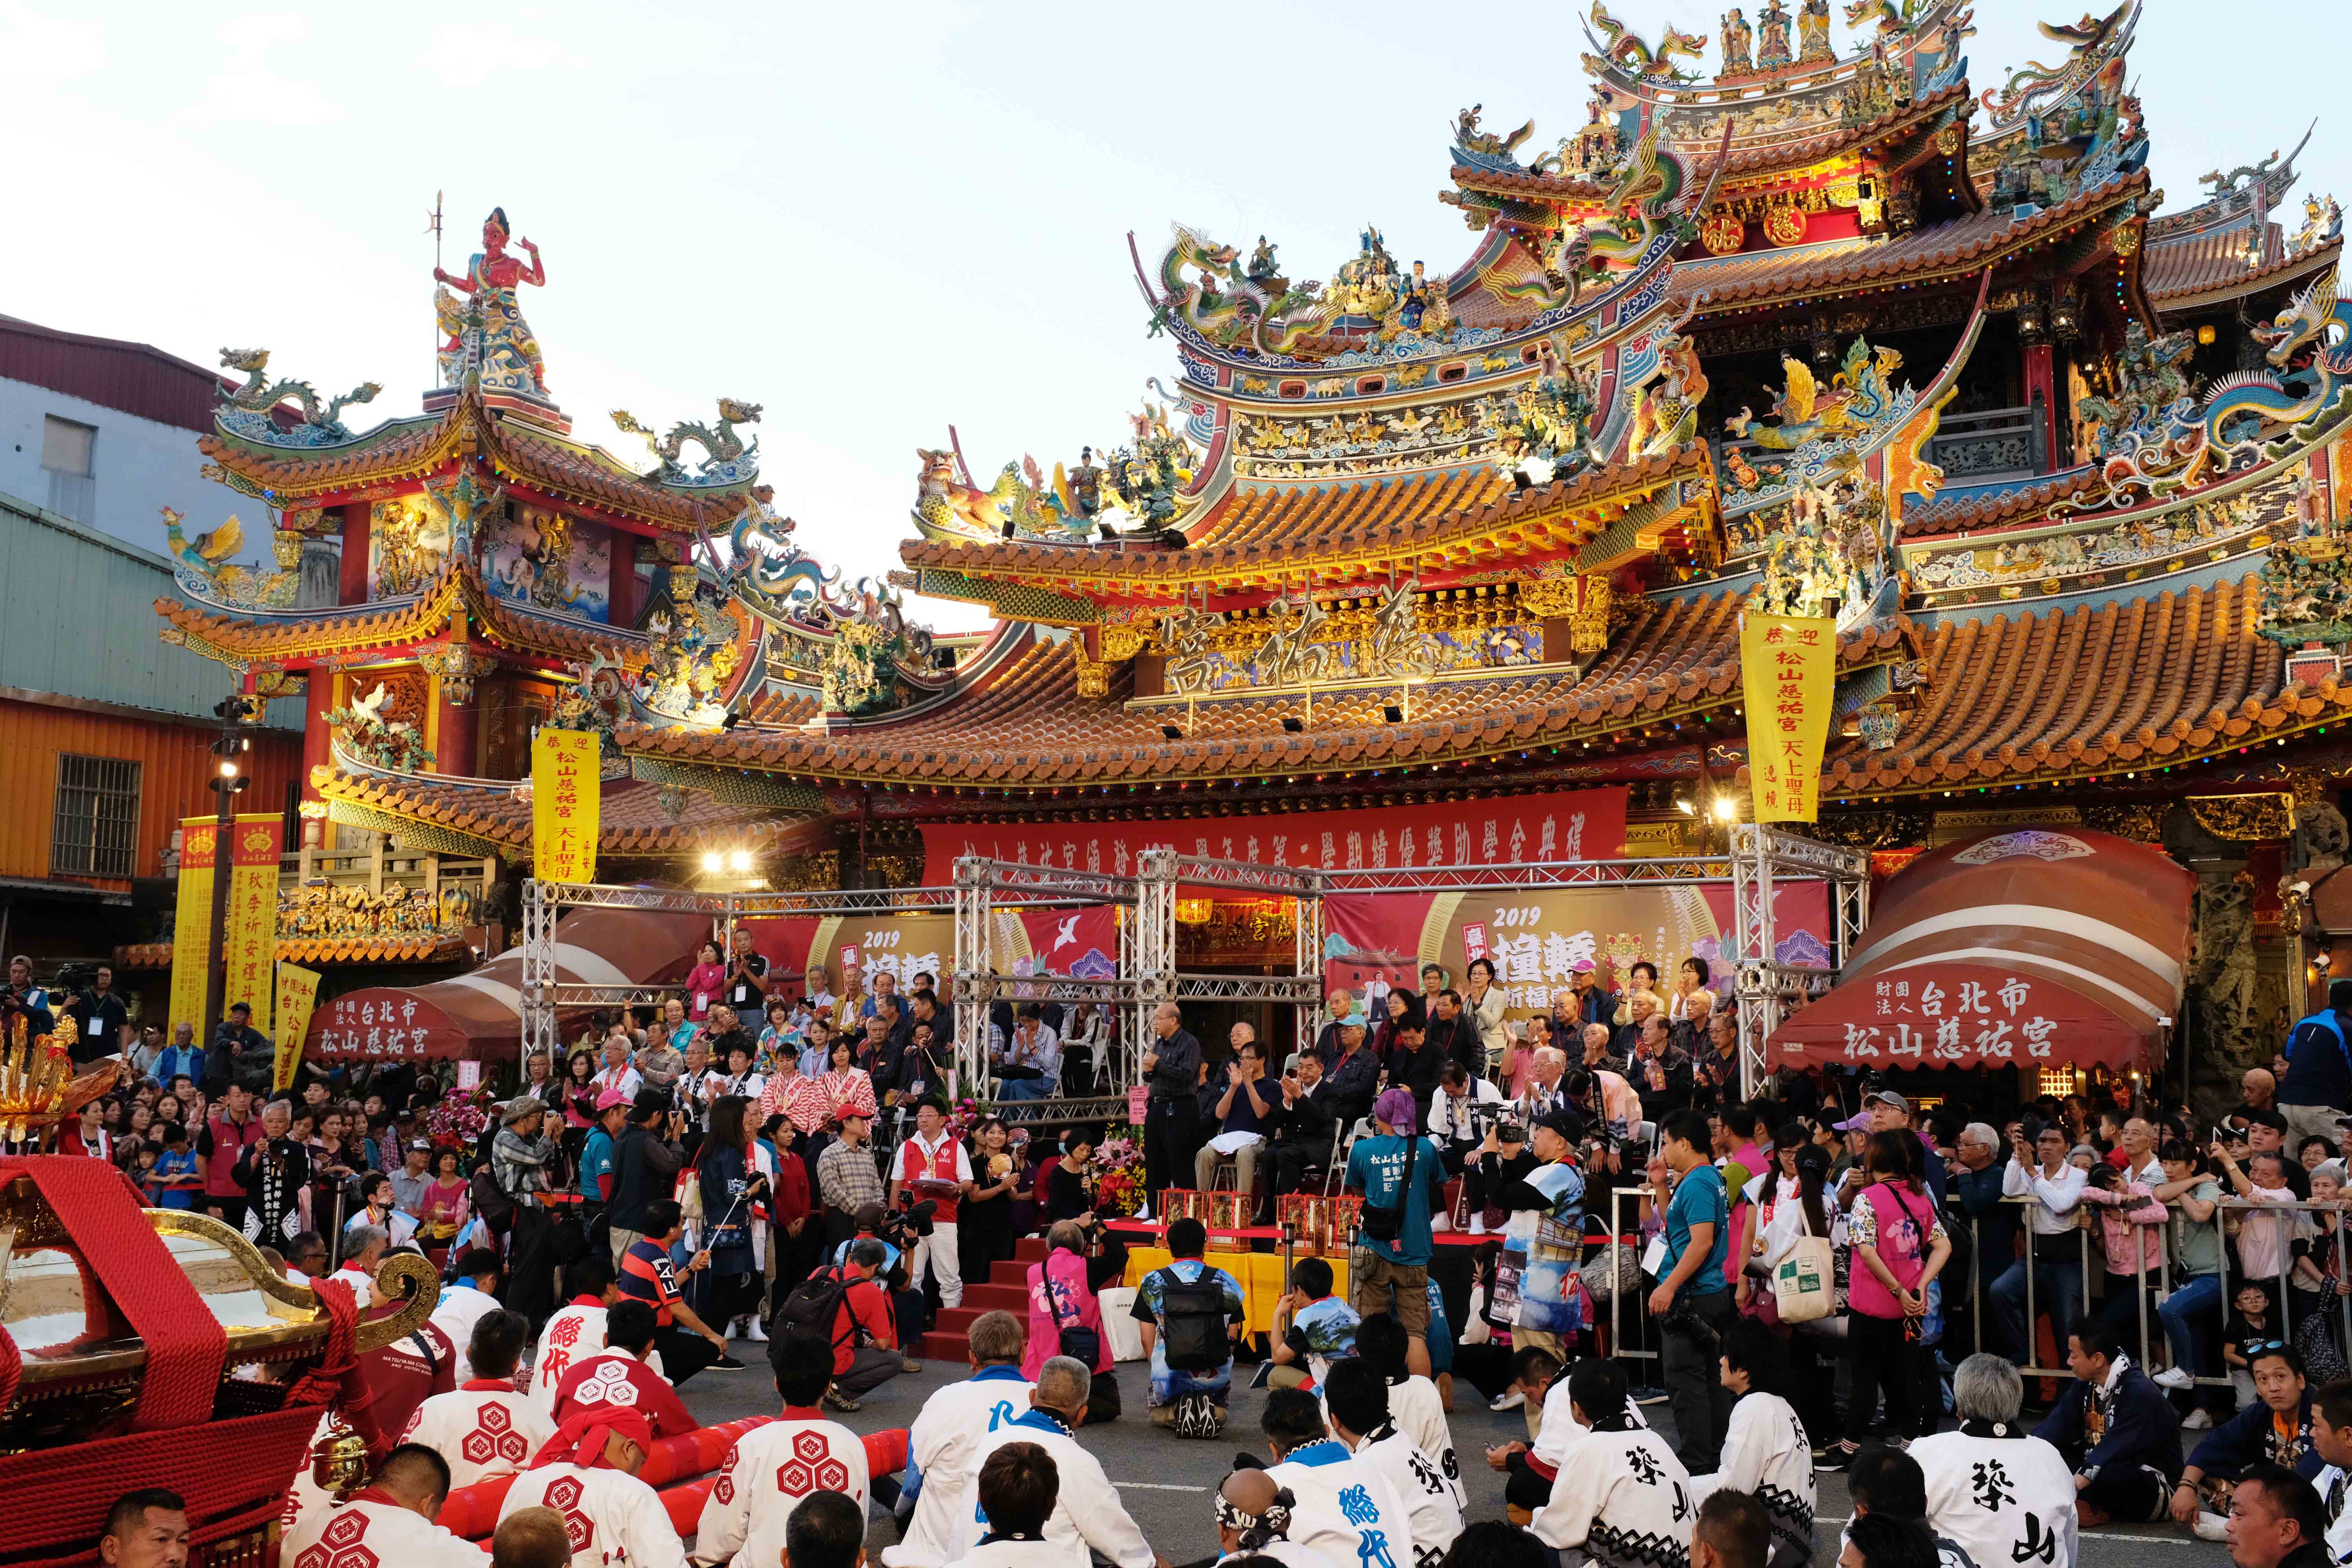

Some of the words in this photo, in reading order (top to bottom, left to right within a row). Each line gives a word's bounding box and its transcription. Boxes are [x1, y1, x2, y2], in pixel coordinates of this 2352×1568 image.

[1764, 628, 1819, 646] 恭迎
[1776, 651, 1806, 732] 松山慈祐宮
[546, 736, 588, 750] 恭迎
[554, 752, 579, 818] 松山慈祐宮
[1780, 740, 1804, 815] 天上聖母
[553, 827, 577, 878] 天上聖母
[1493, 906, 1541, 927] 2019
[863, 930, 900, 948] 2019
[1876, 981, 1909, 997] 財團
[1921, 977, 2031, 1017] 台北市
[335, 1000, 355, 1013] 財團
[361, 998, 418, 1026] 台北市
[1877, 1000, 1913, 1016] 法人
[336, 1013, 356, 1025] 法人
[321, 1027, 428, 1054] 松山慈祐宮
[1844, 1016, 2057, 1060] 松山慈祐宮
[1470, 1097, 1479, 1124] 松山市
[382, 1356, 414, 1365] MATSUYAMA
[404, 1365, 420, 1374] VISITORS
[1971, 1459, 2056, 1565] 築山
